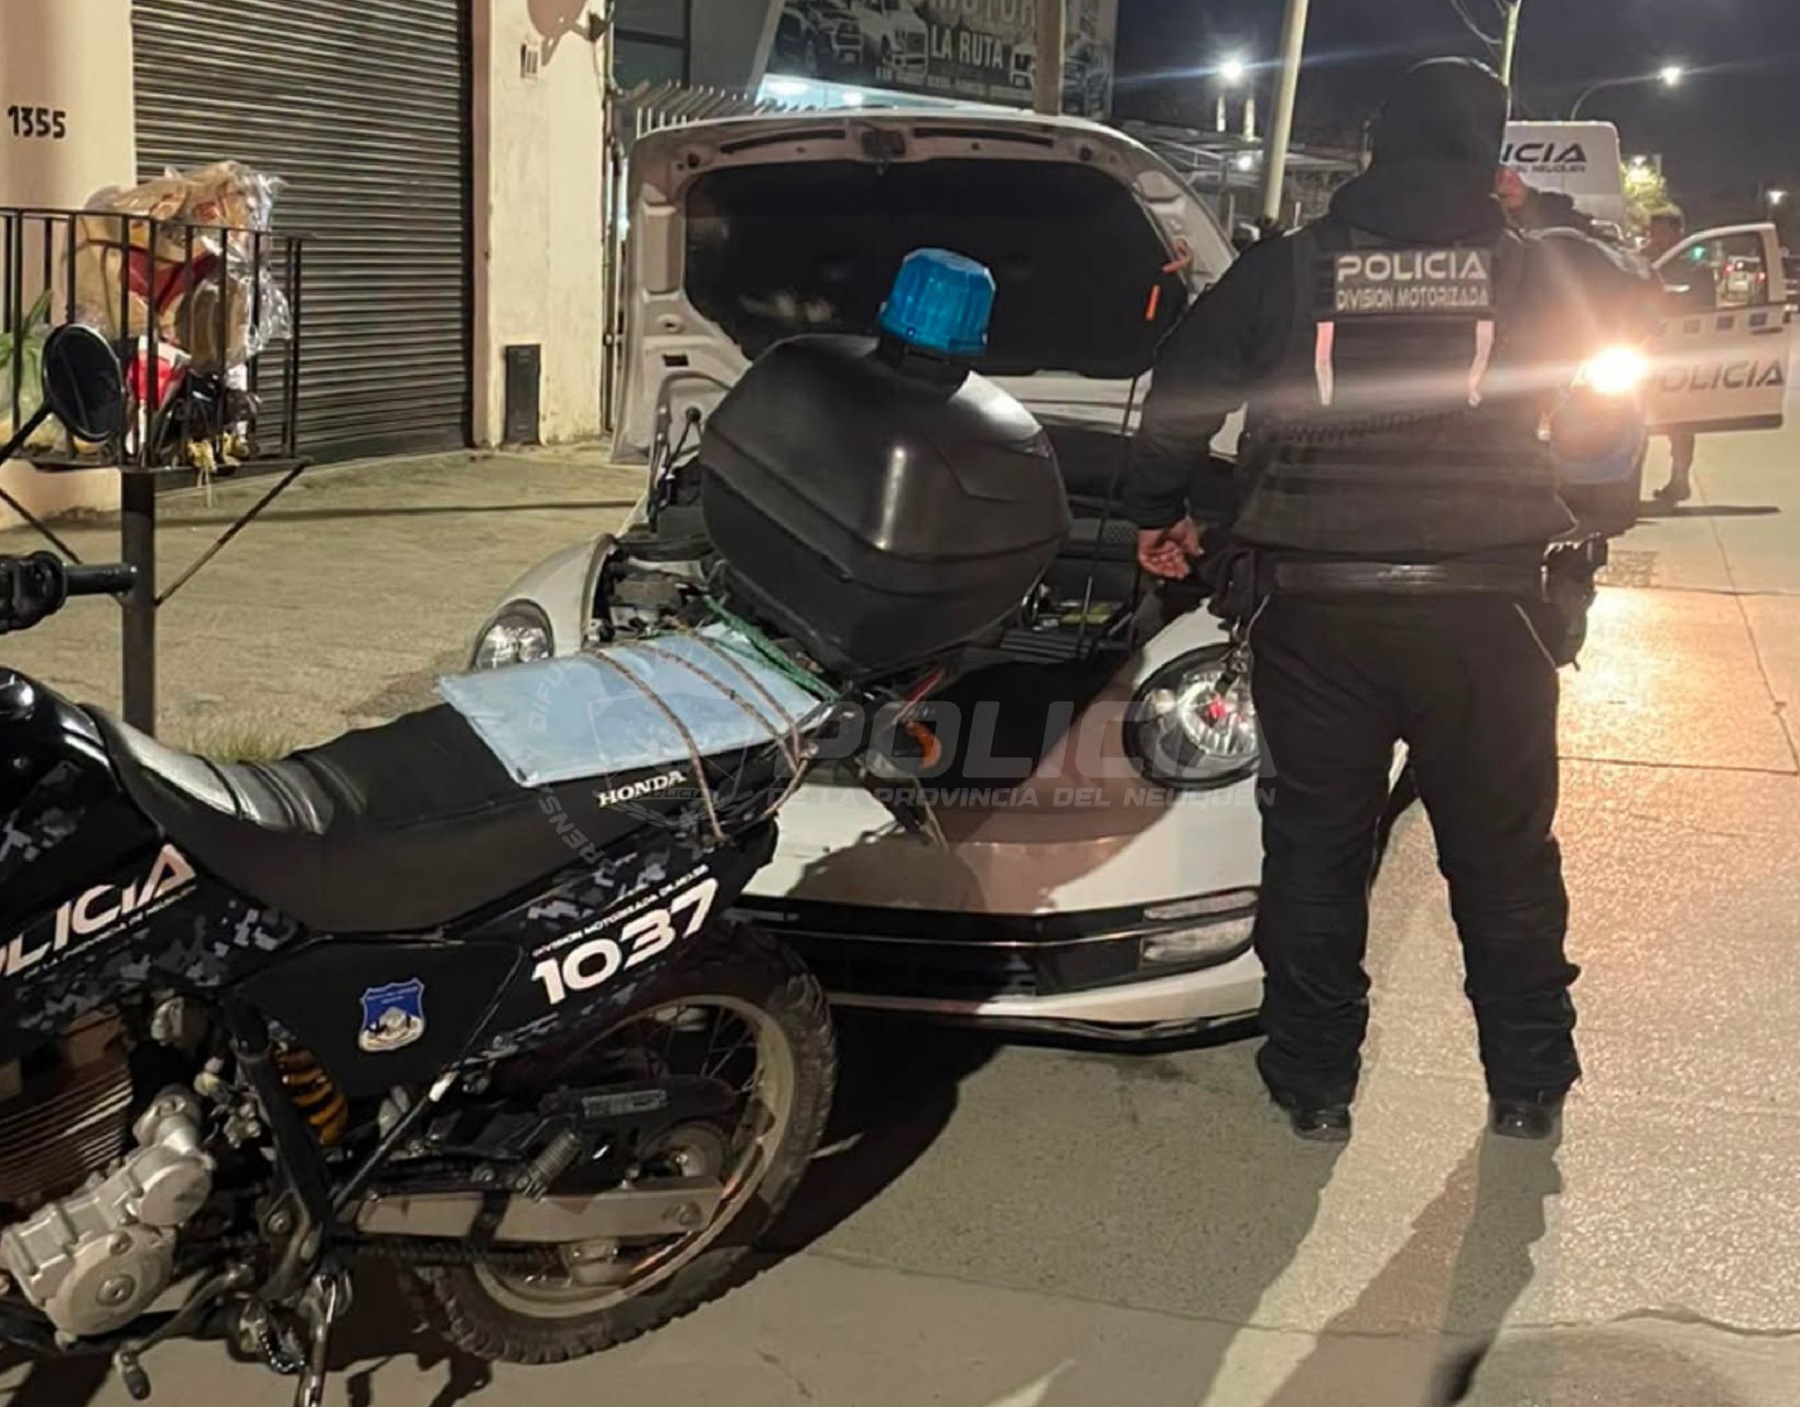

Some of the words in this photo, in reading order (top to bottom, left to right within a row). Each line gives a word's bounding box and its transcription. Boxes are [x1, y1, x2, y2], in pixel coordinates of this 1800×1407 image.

[930, 24, 953, 60] LA
[959, 30, 1004, 70] RUTA
[7, 104, 67, 139] 1355
[1501, 143, 1588, 163] ICIA
[1336, 251, 1488, 282] POLICIA
[1335, 287, 1394, 311] DIVISION
[1396, 284, 1490, 309] MOTORIZADA
[1658, 359, 1786, 393] OLICIA
[599, 769, 688, 808] HONDA
[0, 842, 197, 978] LICIA
[531, 876, 719, 1005] 1037
